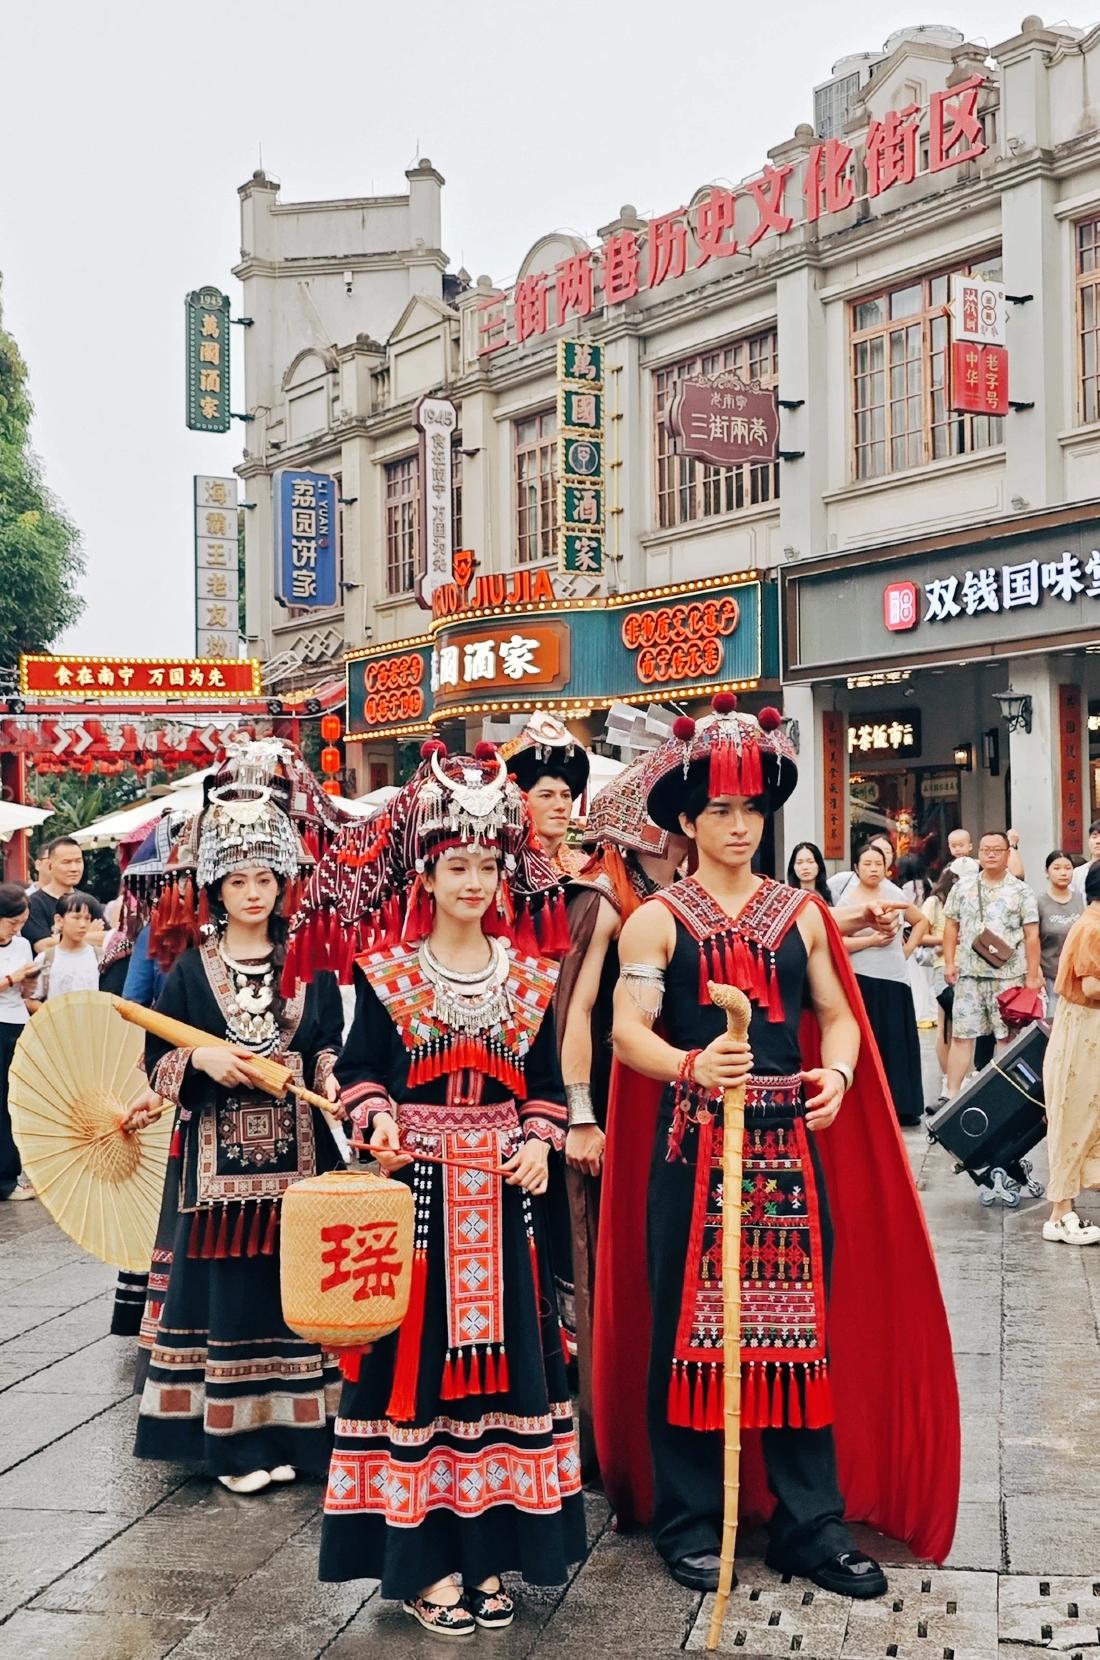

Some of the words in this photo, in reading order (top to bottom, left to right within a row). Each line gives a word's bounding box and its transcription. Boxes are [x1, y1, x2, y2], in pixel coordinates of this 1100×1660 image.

[477, 73, 988, 356] 三街两巷历史文化街区
[200, 295, 223, 306] 1945
[966, 351, 978, 386] 中华
[986, 353, 999, 409] 老字号
[424, 408, 453, 427] 1945
[318, 480, 328, 494] LI
[318, 500, 329, 535] YUAN
[471, 569, 555, 607] JIUJIA
[623, 598, 738, 647] 非物质文化遗产
[54, 664, 135, 687] 食在南宁
[148, 666, 226, 687] 万国为先
[639, 639, 722, 682] 南宁传承菜
